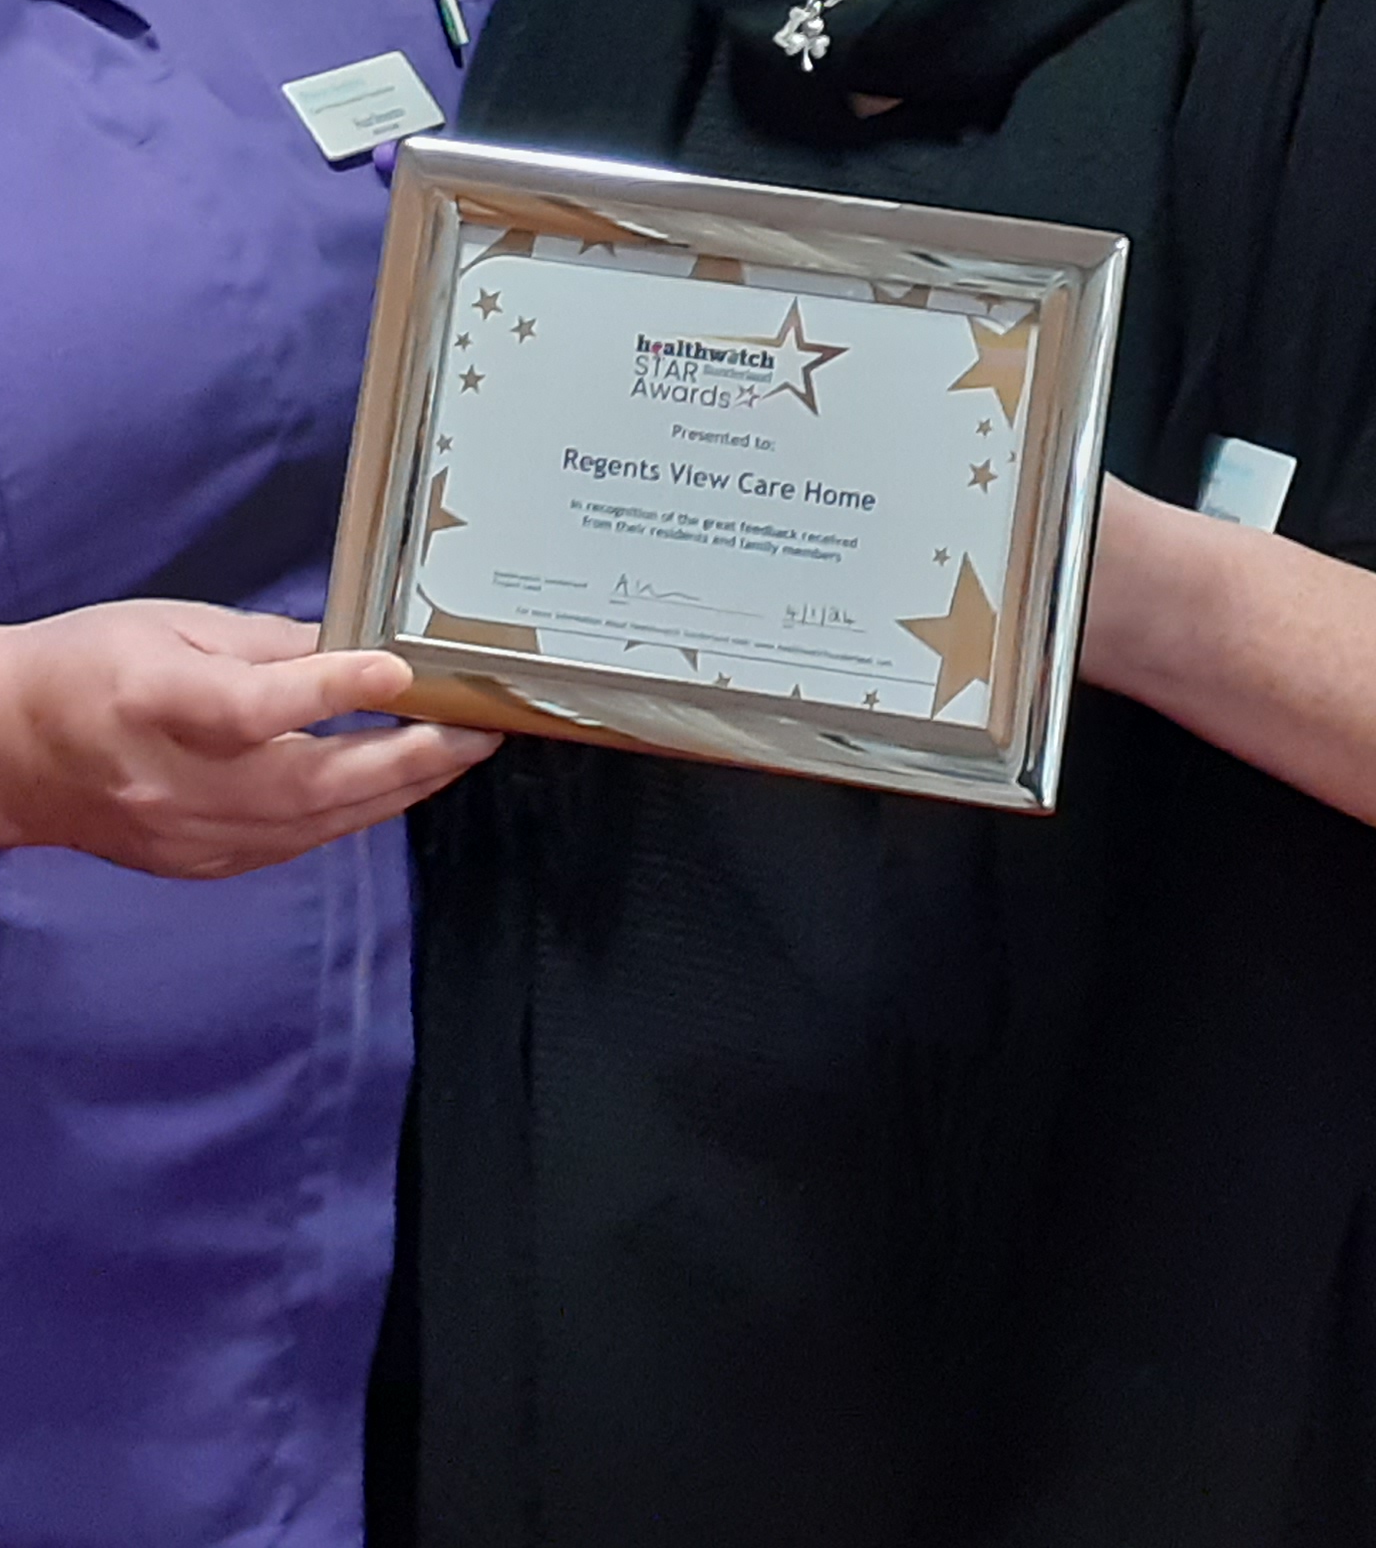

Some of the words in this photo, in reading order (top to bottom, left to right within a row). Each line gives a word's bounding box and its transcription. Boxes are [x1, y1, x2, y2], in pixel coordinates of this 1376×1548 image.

[634, 355, 698, 383] STAR
[636, 333, 774, 369] healthwatch
[630, 377, 731, 409] Awards
[672, 424, 750, 448] Presented
[562, 448, 661, 481] Regents
[670, 462, 731, 490] View
[738, 472, 795, 500] Care
[804, 480, 876, 511] Home
[586, 501, 658, 522] recognition
[661, 509, 674, 522] of
[677, 511, 699, 526] the
[703, 515, 736, 532] great
[740, 520, 797, 541] feedback
[802, 530, 858, 549] received
[616, 519, 644, 535] their
[650, 525, 708, 544] residents
[712, 533, 736, 548] and
[740, 536, 778, 555] family
[781, 543, 842, 563] members
